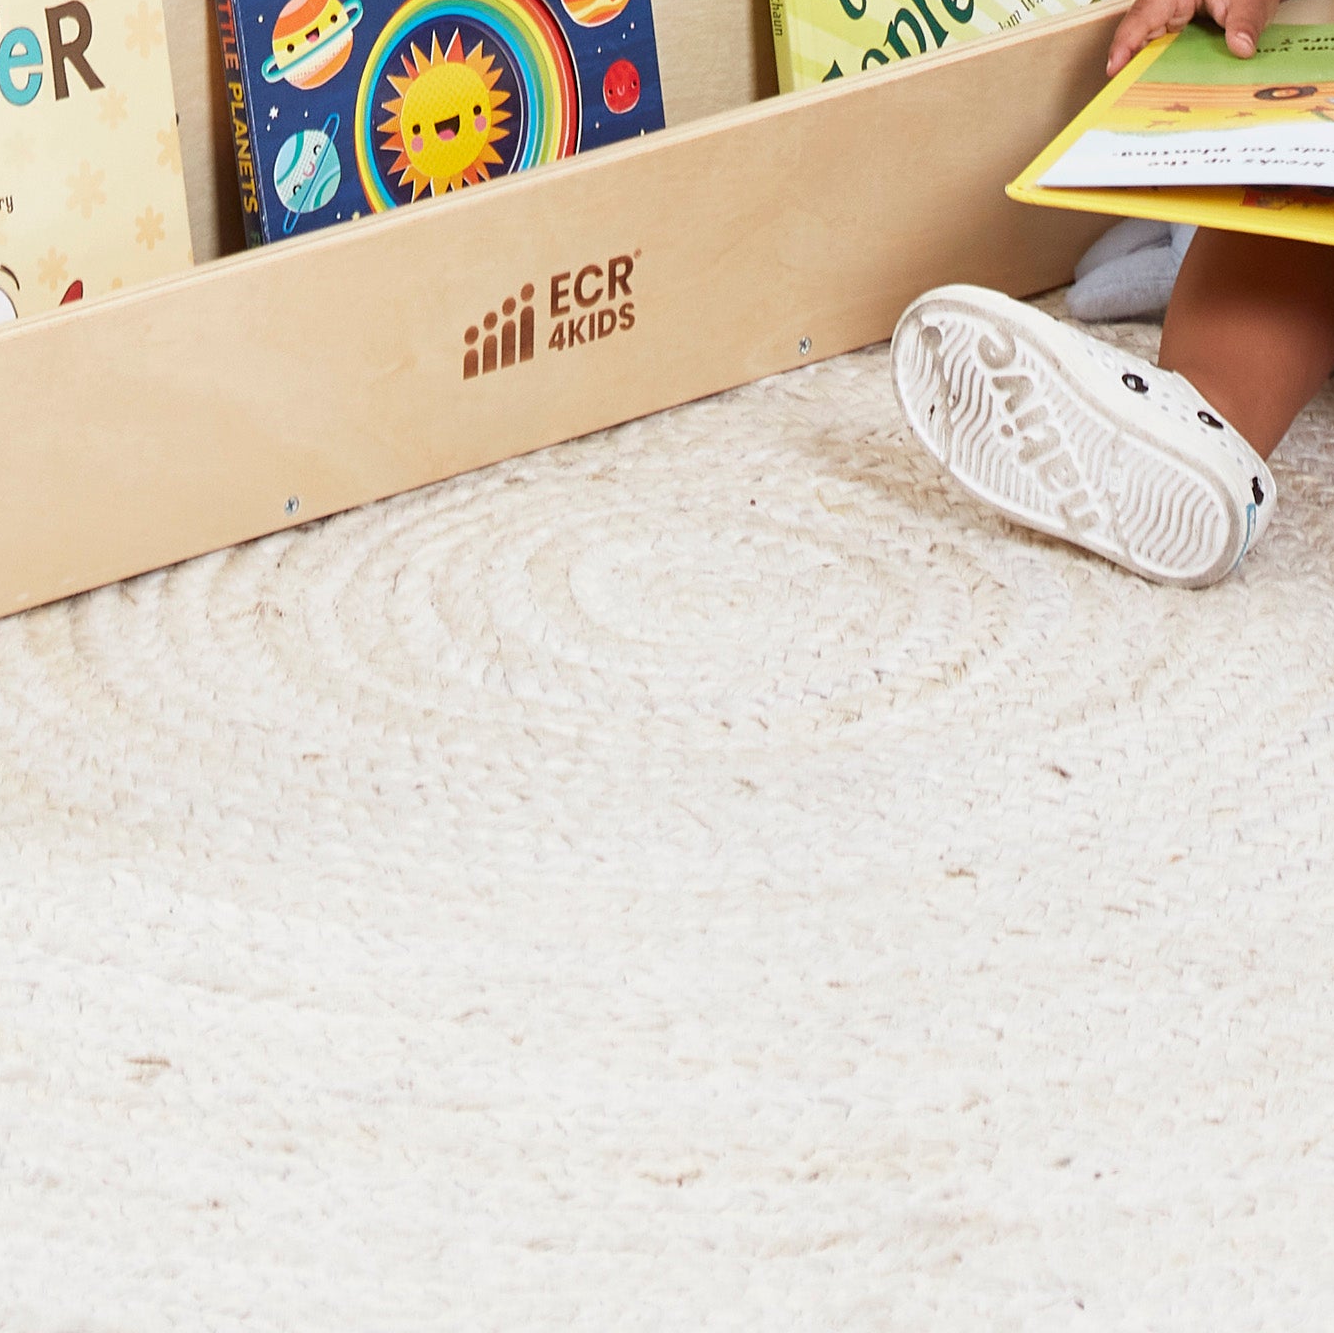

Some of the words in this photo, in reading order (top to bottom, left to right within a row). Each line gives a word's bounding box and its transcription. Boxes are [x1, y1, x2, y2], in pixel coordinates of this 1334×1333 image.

[227, 81, 259, 214] PLANETS
[548, 301, 635, 352] 4KIDS
[975, 331, 1101, 532] native
